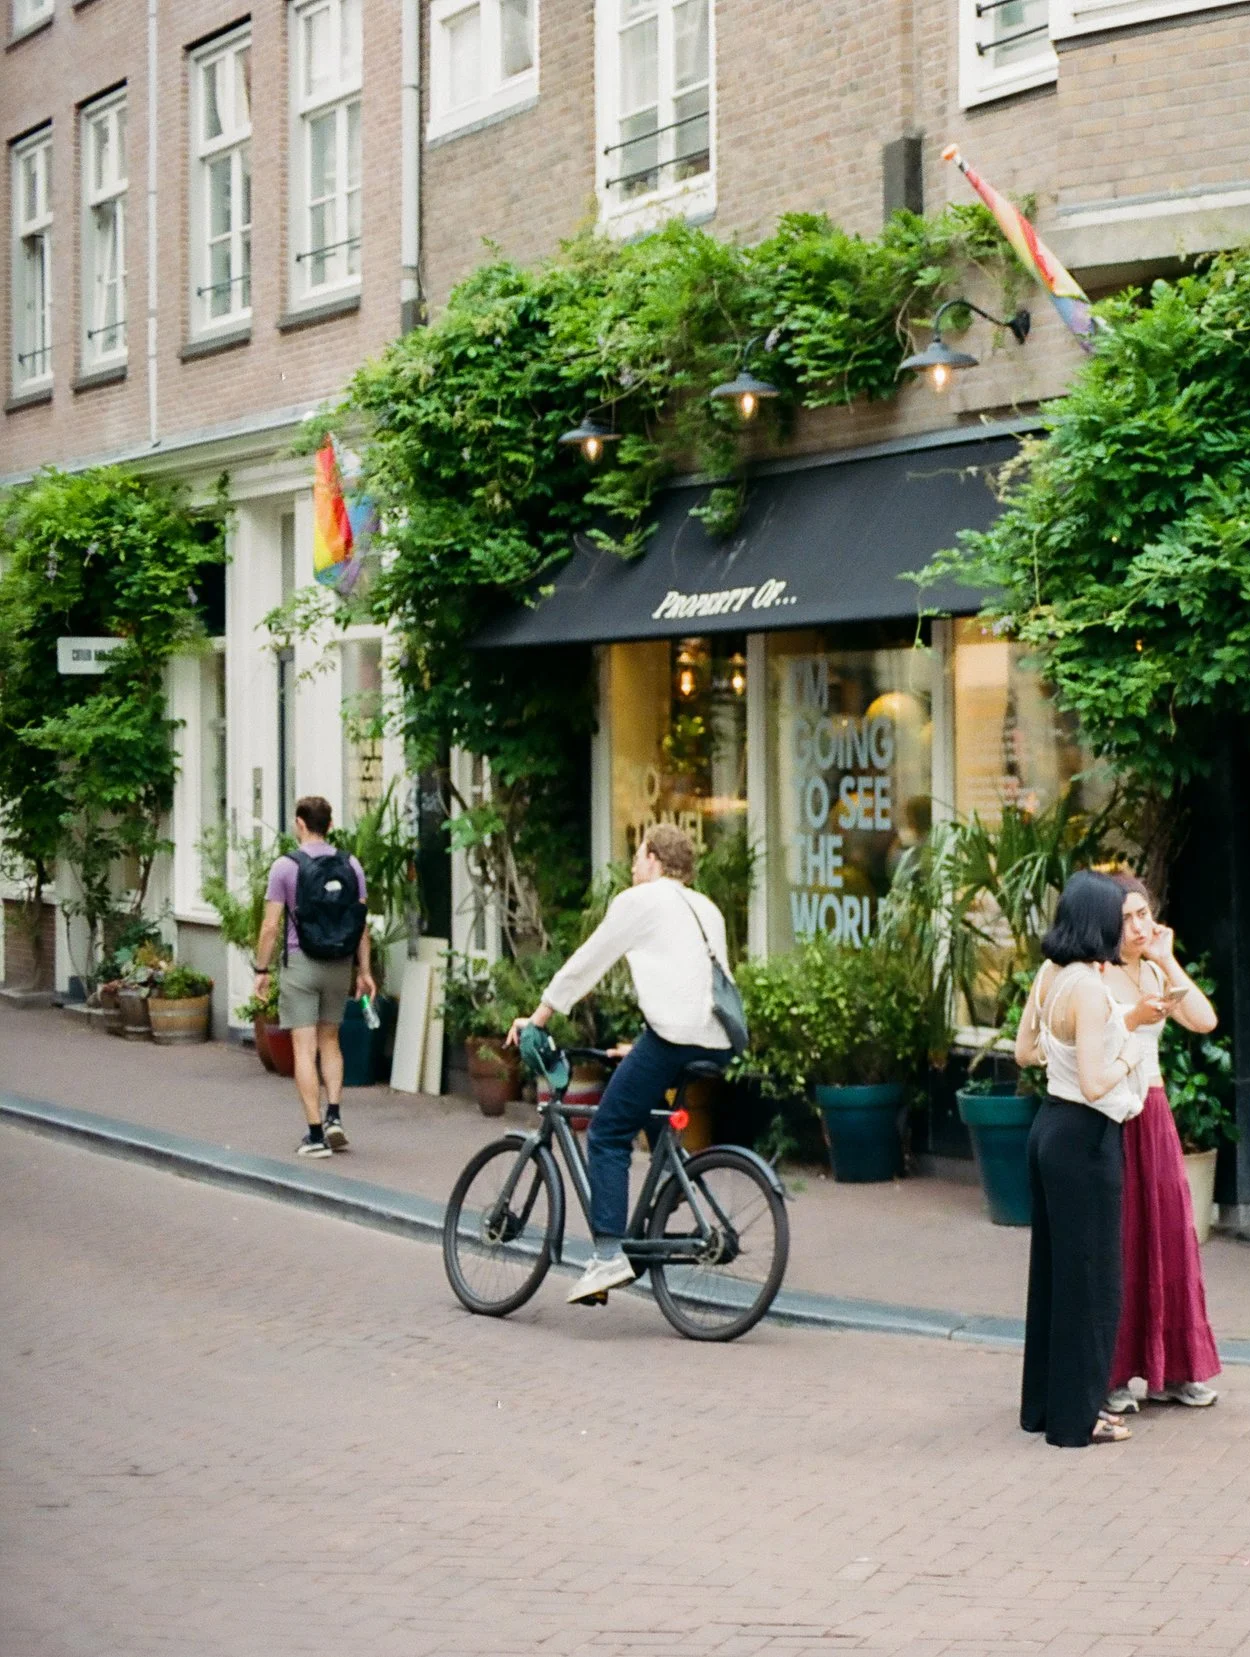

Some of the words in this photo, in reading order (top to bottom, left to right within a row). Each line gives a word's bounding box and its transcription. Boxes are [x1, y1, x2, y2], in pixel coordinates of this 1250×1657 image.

[651, 586, 756, 619] PROPERTY
[791, 716, 894, 770] GOING
[790, 775, 829, 829] TO
[838, 775, 893, 831] SEE
[790, 833, 843, 888] THE
